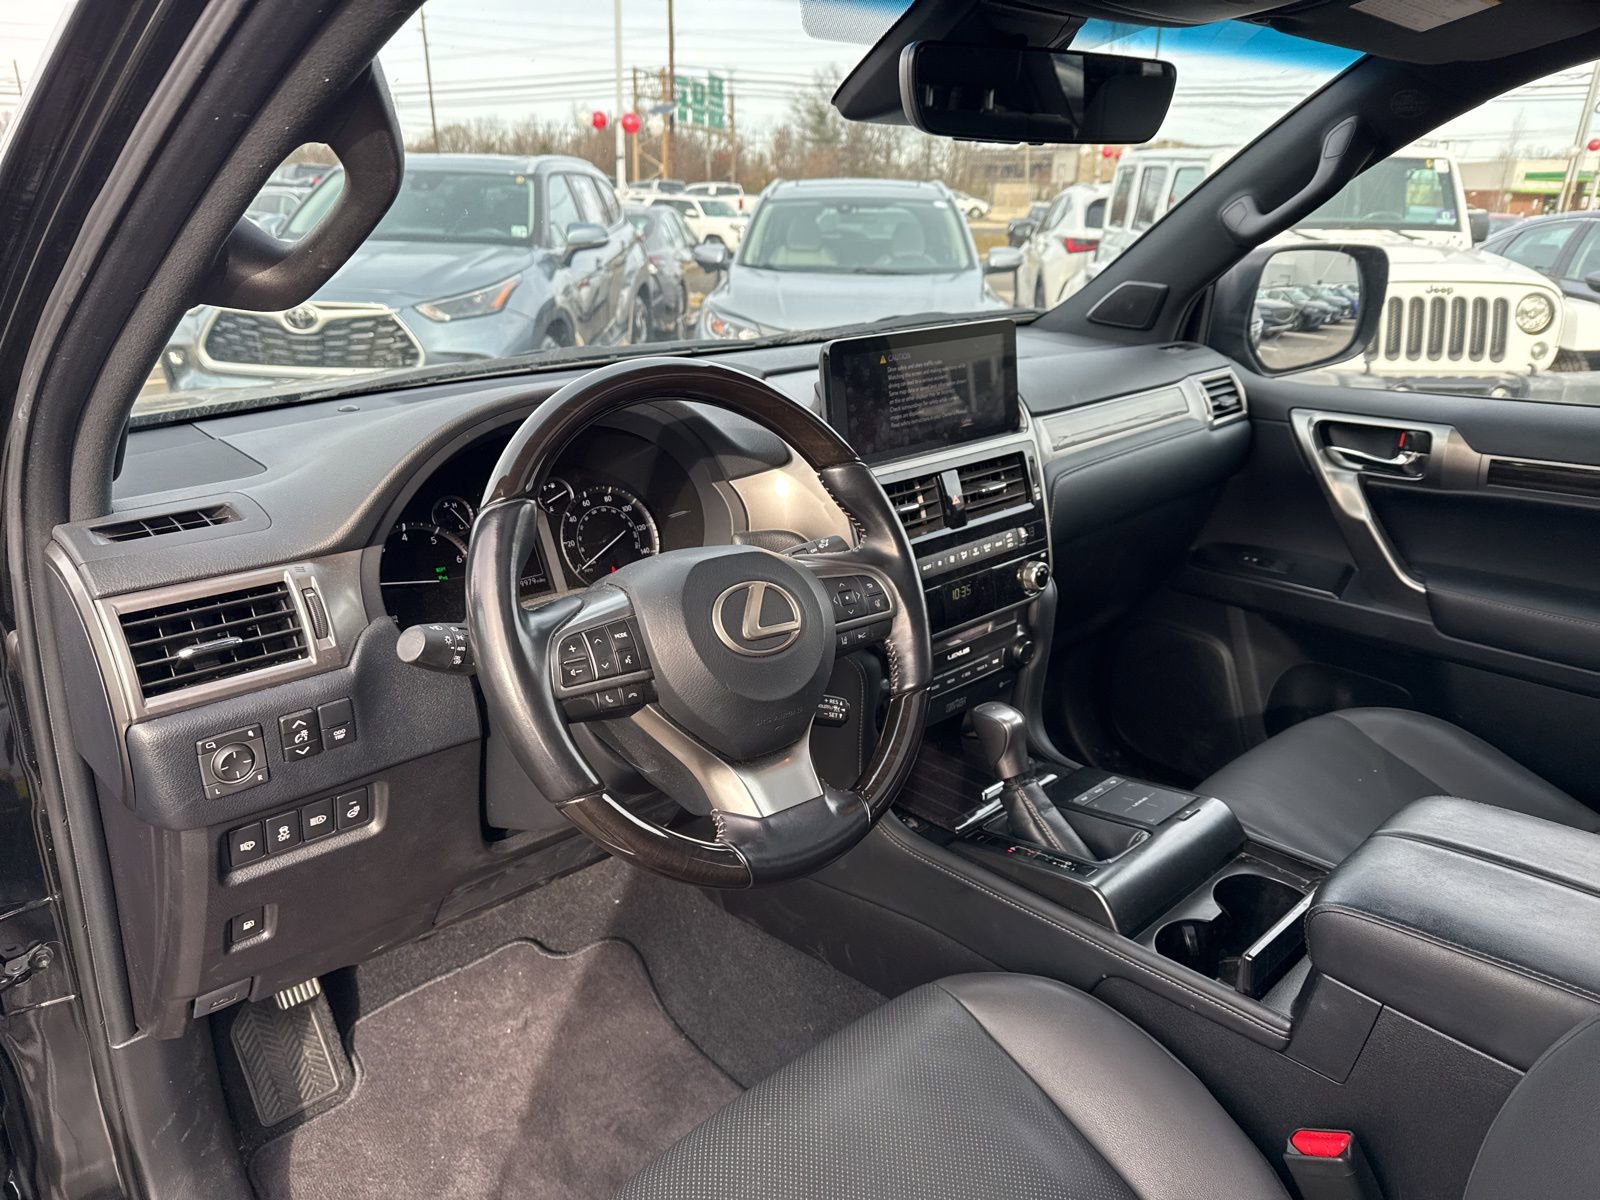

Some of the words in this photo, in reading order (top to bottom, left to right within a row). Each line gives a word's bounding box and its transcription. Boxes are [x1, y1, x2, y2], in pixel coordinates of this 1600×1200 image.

[1425, 284, 1454, 296] Jeep
[604, 495, 612, 503] 80
[622, 504, 632, 512] 100
[636, 523, 647, 532] 120
[401, 533, 408, 542] 4
[430, 537, 438, 545] 5
[567, 540, 575, 548] 20
[640, 546, 650, 555] 140
[456, 555, 463, 564] 6
[952, 584, 972, 600] 10:35
[614, 631, 628, 639] MODE
[947, 646, 971, 661] LEXUS
[333, 728, 346, 736] ODO
[335, 733, 346, 741] TRIP
[278, 833, 290, 842] OFF
